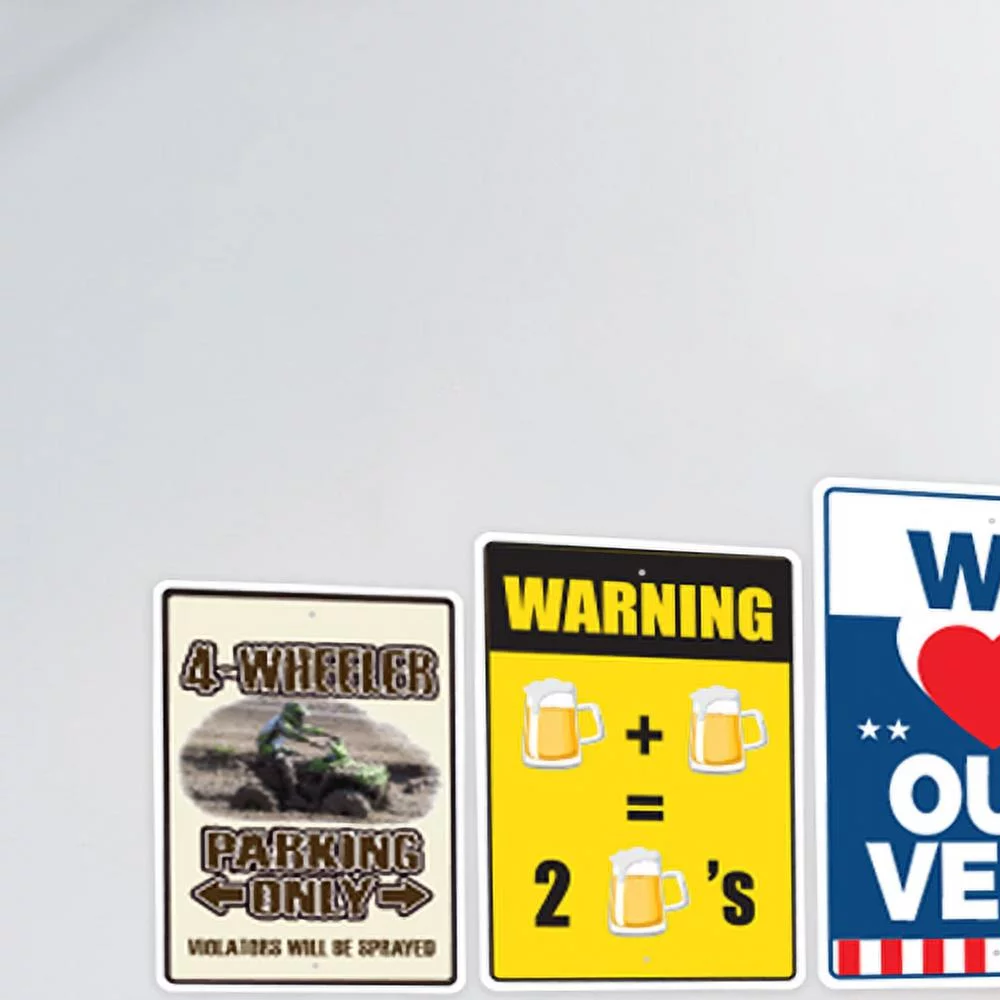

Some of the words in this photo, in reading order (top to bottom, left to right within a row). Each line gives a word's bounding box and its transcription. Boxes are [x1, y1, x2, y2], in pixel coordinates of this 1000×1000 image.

[502, 575, 773, 642] WARNING
[179, 639, 440, 700] 4-WHEELER
[201, 826, 425, 874] PARKING
[247, 874, 379, 921] ONLY
[534, 859, 571, 927] 2
[188, 938, 282, 956] VIOLATORS
[287, 939, 327, 956] WILL
[332, 939, 353, 956] BE
[358, 939, 437, 956] SPRAYED
